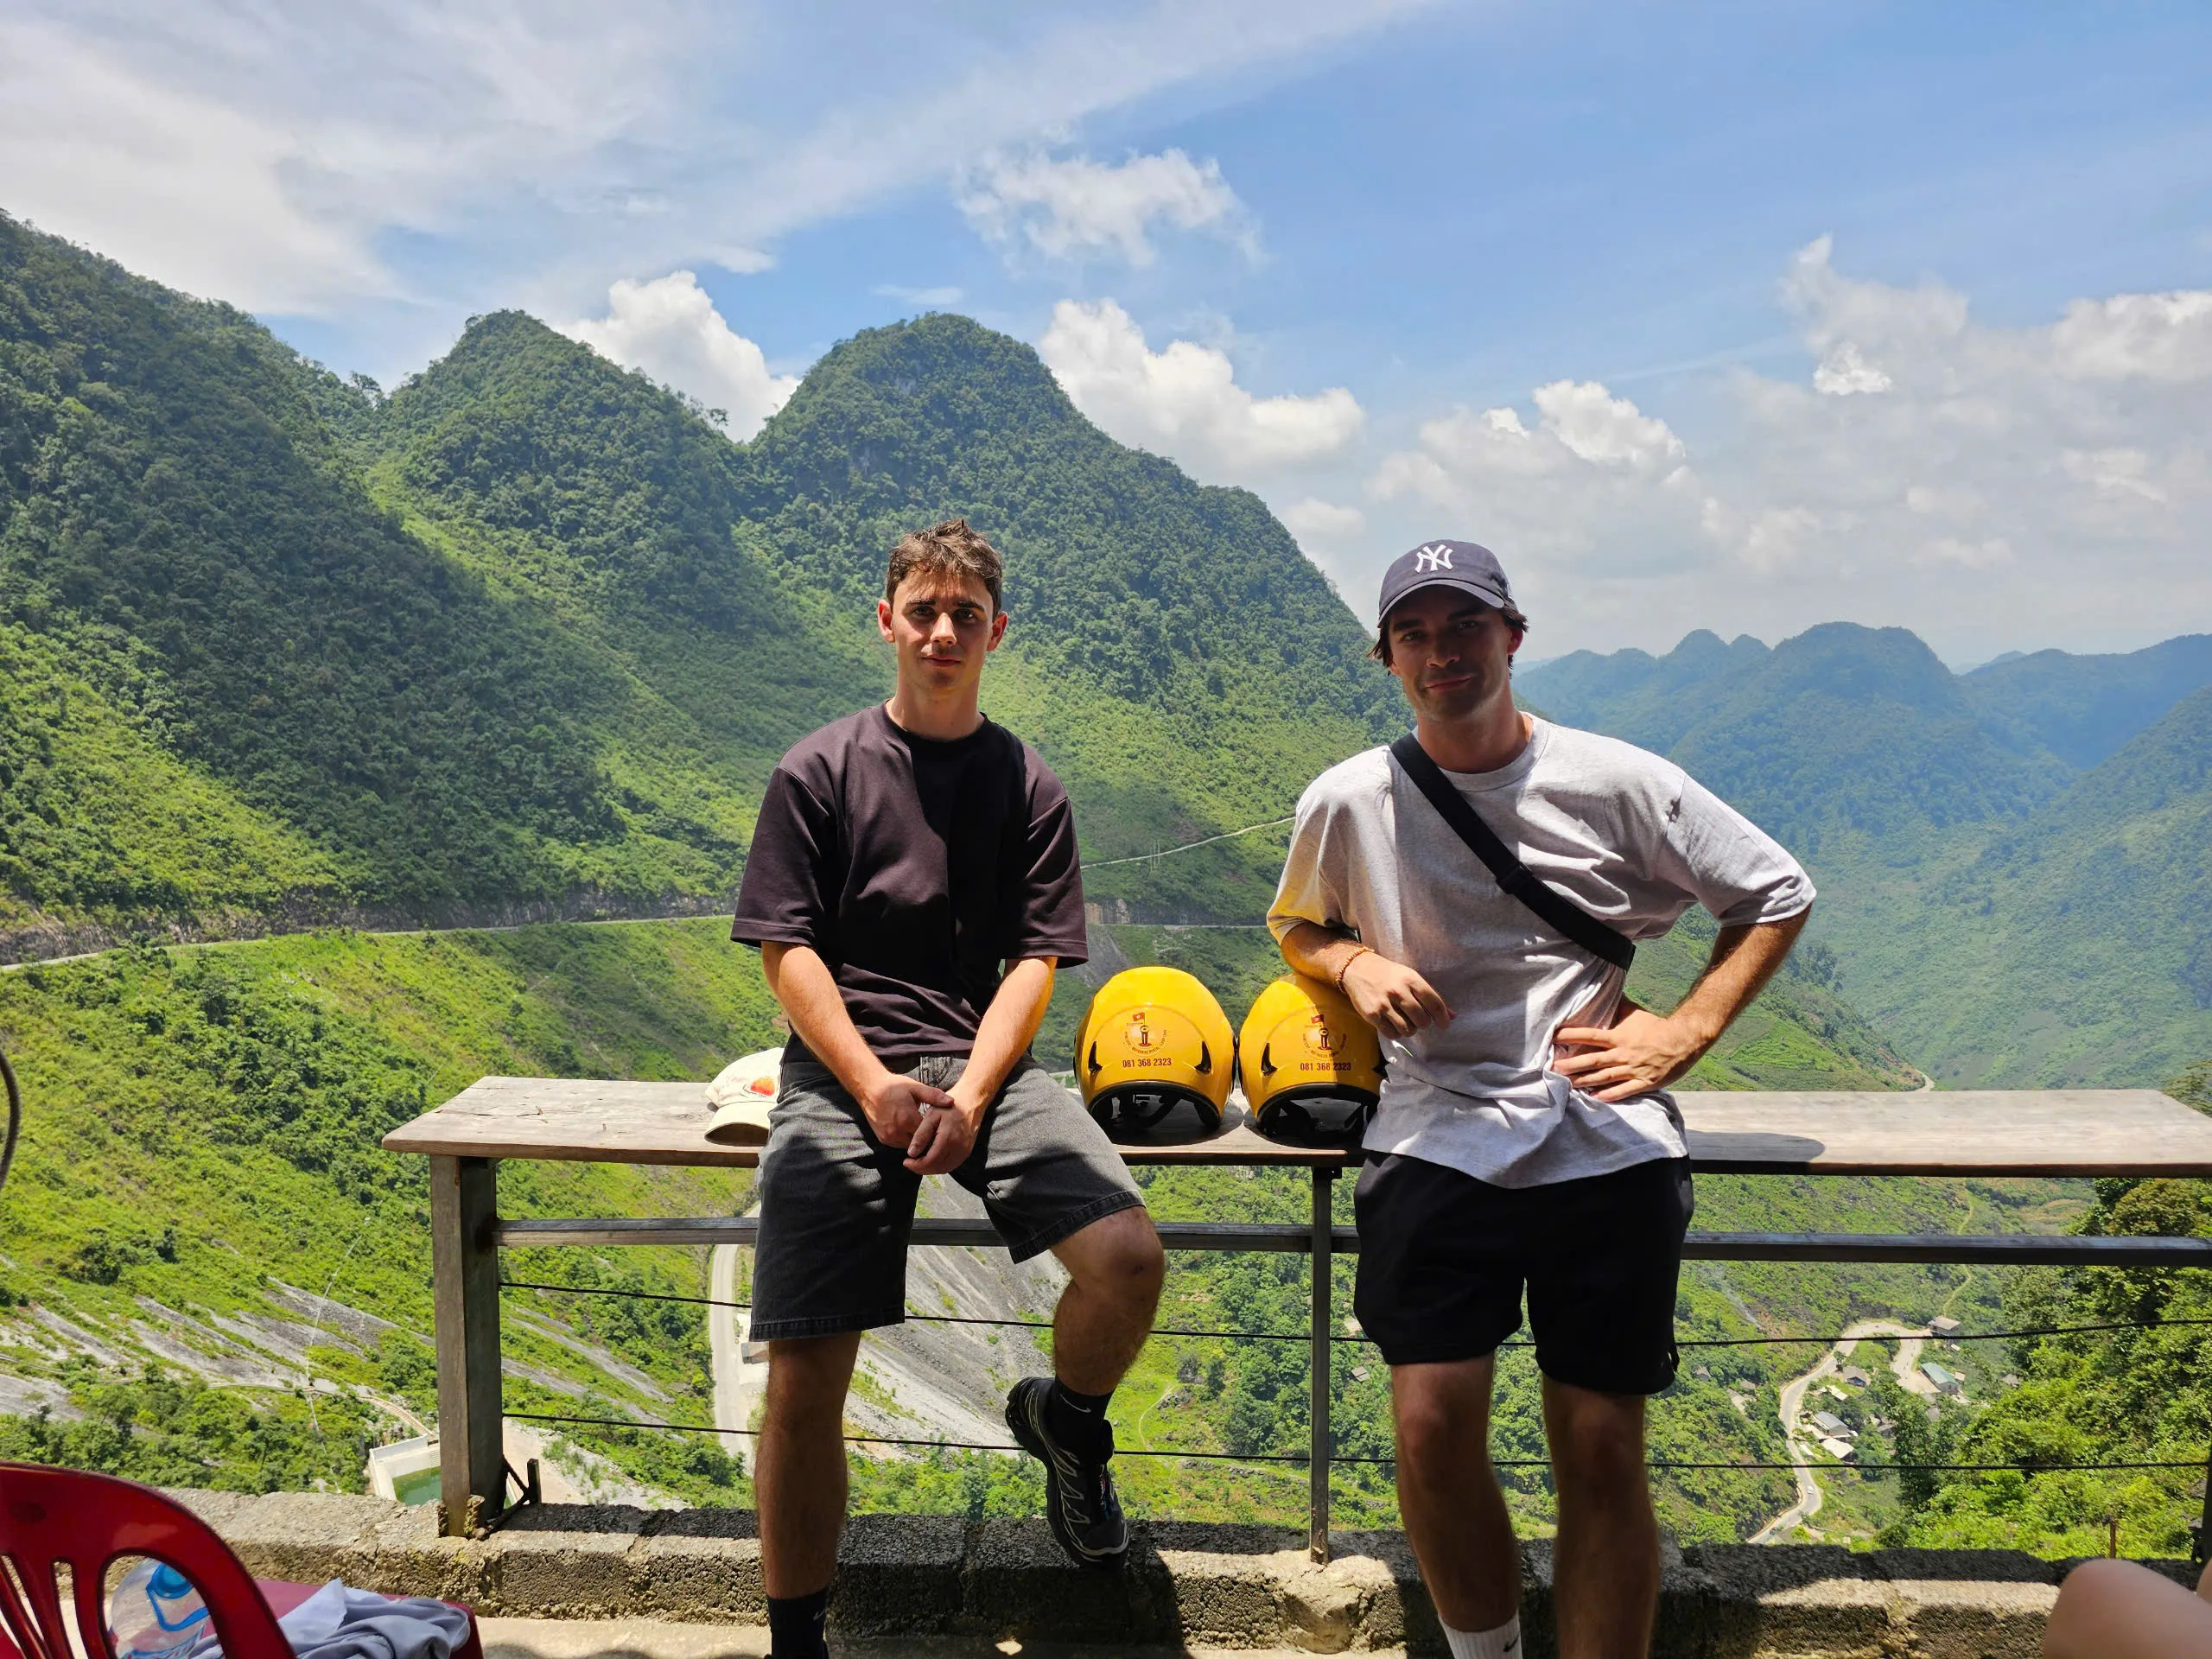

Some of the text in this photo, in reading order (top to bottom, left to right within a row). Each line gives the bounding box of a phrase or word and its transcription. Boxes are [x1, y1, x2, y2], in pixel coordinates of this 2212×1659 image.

[1122, 1058, 1172, 1068] 081 368 2323
[1300, 1062, 1351, 1071] 081 368 2323
